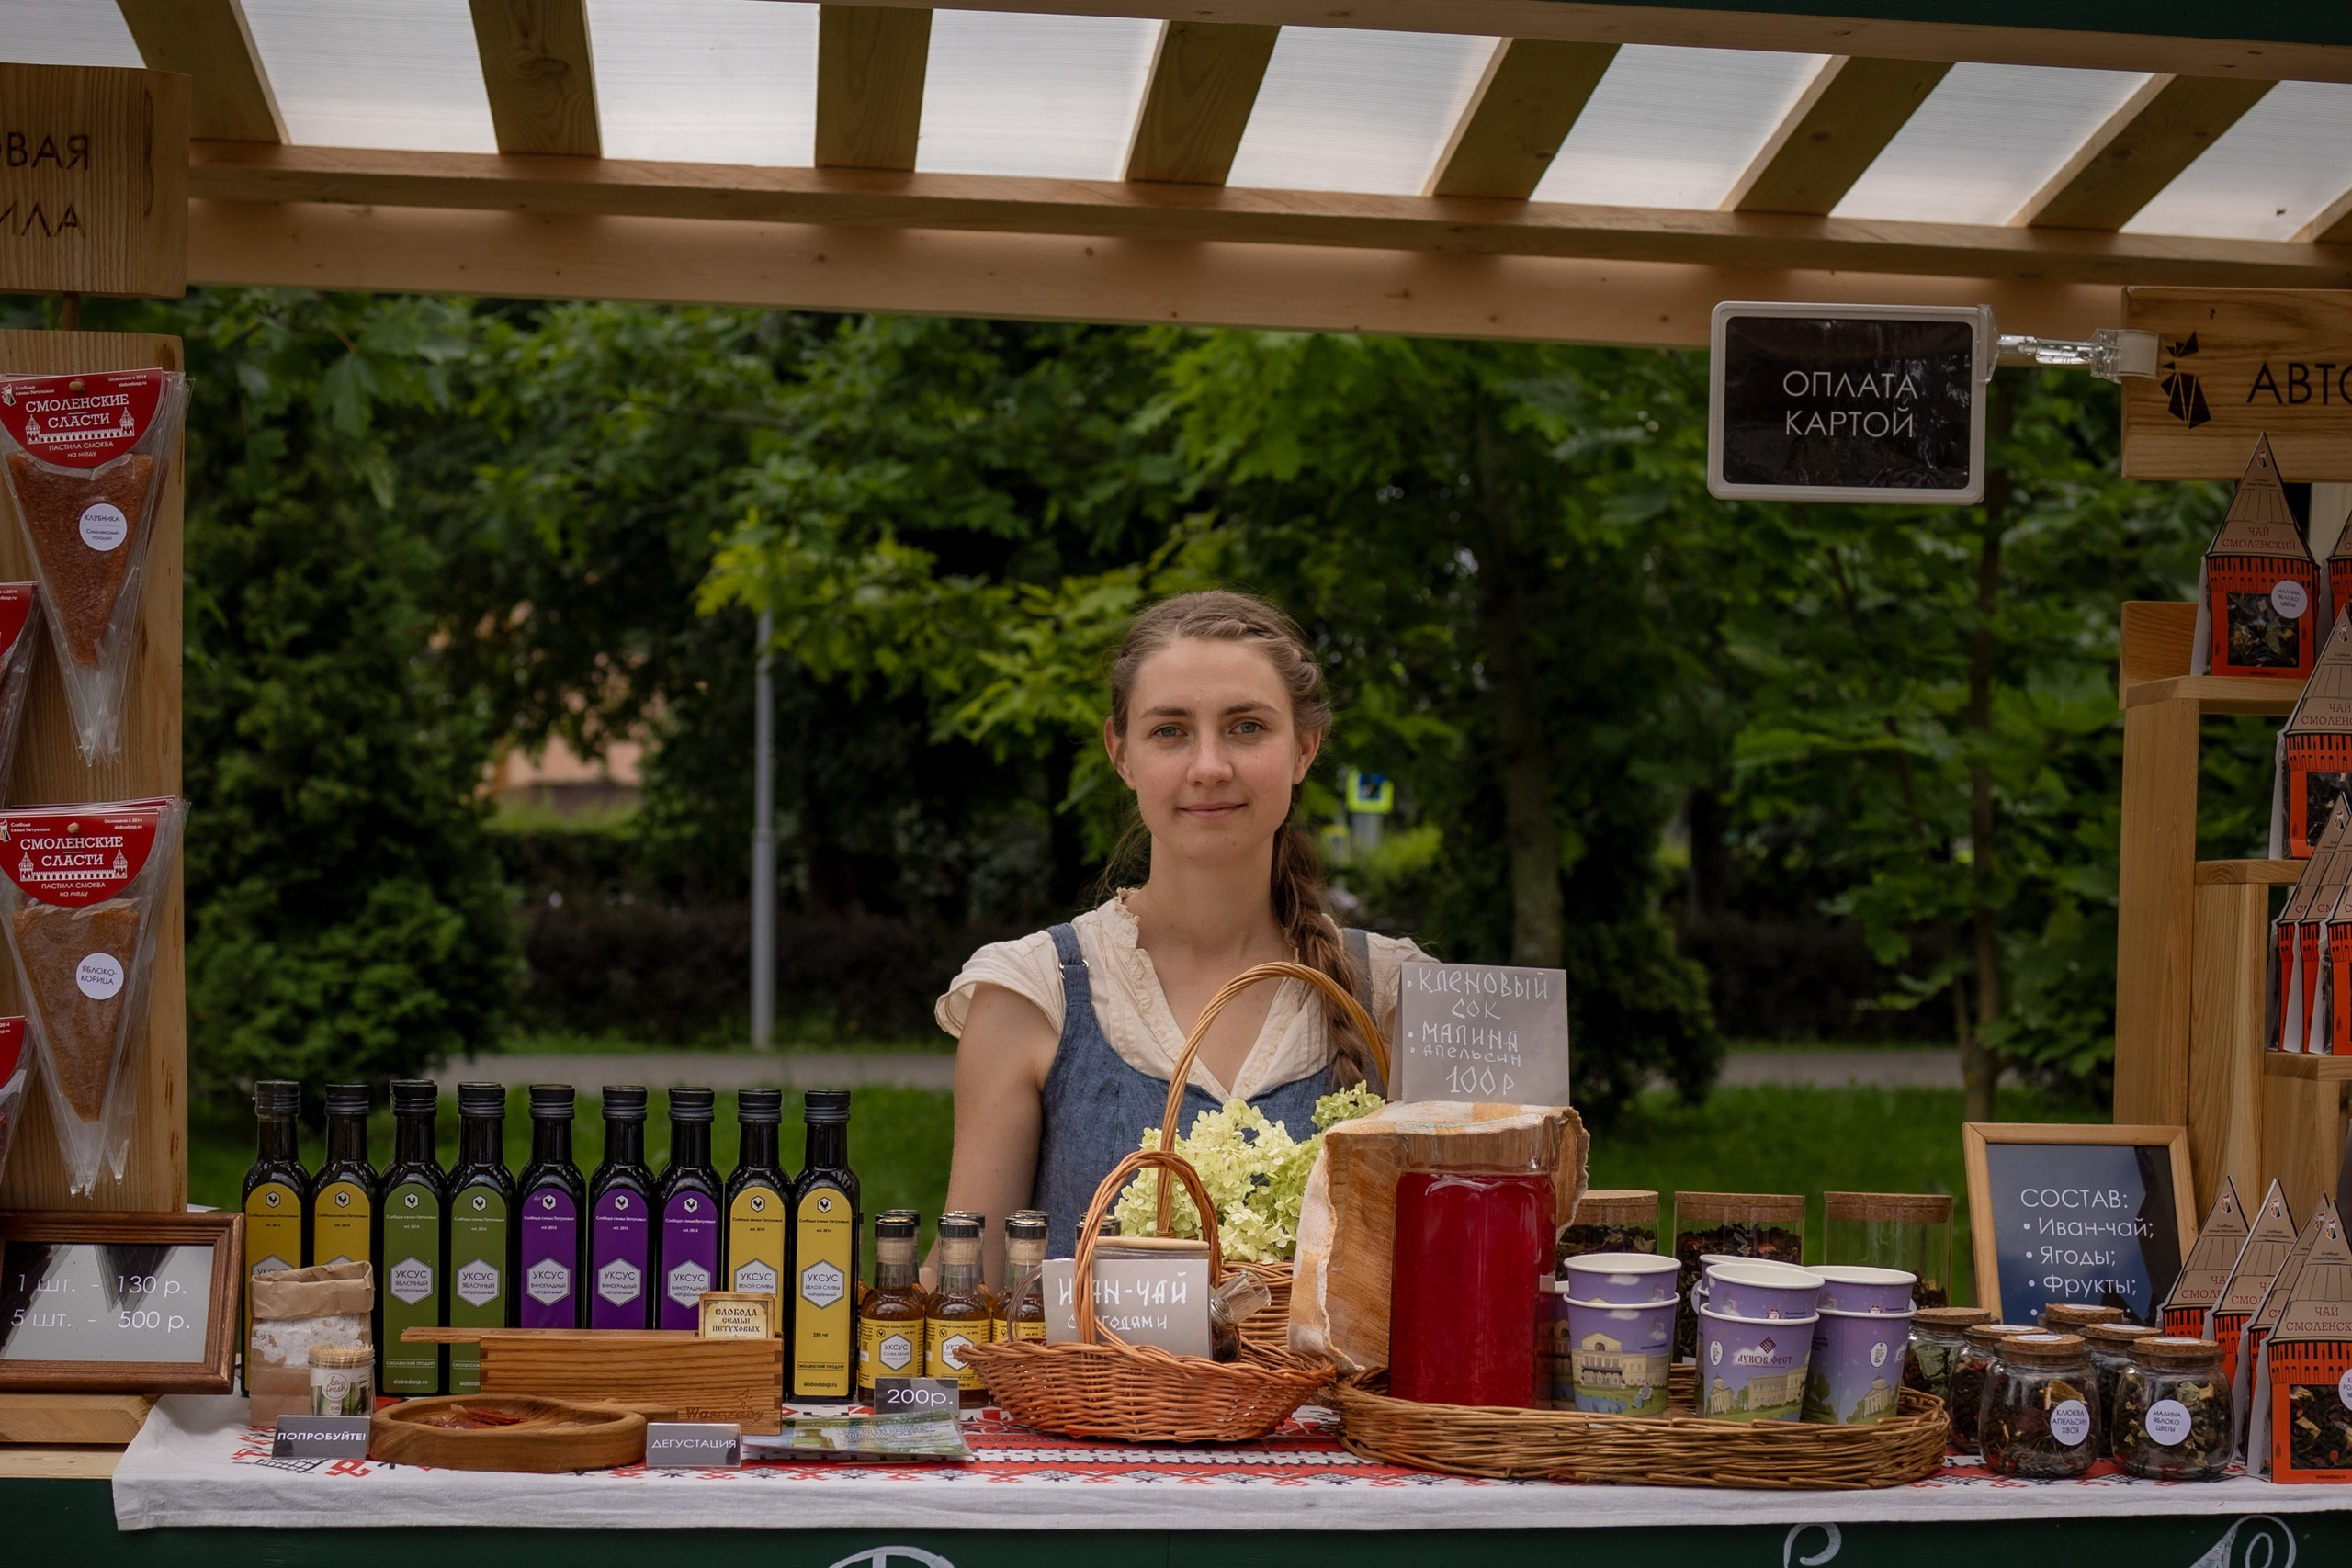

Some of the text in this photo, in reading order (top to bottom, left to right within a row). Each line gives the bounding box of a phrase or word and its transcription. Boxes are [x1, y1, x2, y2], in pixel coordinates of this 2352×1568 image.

[0, 132, 89, 170] ВАЯ
[1783, 370, 1918, 400] ОПЛАТА
[26, 393, 130, 413] СМОЛЕНСКИЕ
[48, 413, 111, 429] СЛАСТИ
[1785, 406, 1914, 438] КАРТОЙ
[49, 441, 114, 452] ПАСТИЛА СМОКВА
[77, 450, 97, 458] меду
[85, 514, 120, 523] КЛУБНИКА
[2248, 526, 2270, 536] ЧАЙ
[2222, 538, 2296, 550] СМОЛЕНСКИЙ
[2329, 703, 2352, 713] ЧАЙ
[20, 836, 124, 851] СМОЛЕНСКИЕ
[41, 854, 105, 867] СЛАСТИ
[81, 965, 118, 976] ЯБЛОКО-
[81, 976, 114, 986] КОРИЦА
[1419, 967, 1549, 1000] КЛЕНОВЫЙ
[1452, 998, 1501, 1020] СОК
[1422, 1021, 1519, 1053] МАЛИНА
[2020, 1188, 2129, 1209] СОСТАВ:
[2038, 1216, 2154, 1239] Иван-чай;
[2040, 1246, 2117, 1267] Ягоды;
[395, 1270, 428, 1279] УКСУС
[533, 1271, 564, 1280] УКСУС
[605, 1271, 636, 1280] УКСУС
[673, 1273, 706, 1282] УКСУС
[741, 1272, 772, 1281] УКСУС
[807, 1273, 839, 1282] УКСУС
[18, 1274, 26, 1292] 1
[37, 1279, 75, 1292] шт.
[118, 1275, 157, 1293] 130
[164, 1280, 187, 1298] р.
[1058, 1271, 1187, 1307] ИАН-ЧАЙ
[2043, 1274, 2137, 1299] Фрукты;
[715, 1308, 757, 1317] СЛОБОДА
[2315, 1304, 2339, 1316] ЧАЙ
[11, 1308, 25, 1327] 5
[33, 1314, 72, 1327] шт.
[118, 1311, 161, 1329] 500
[167, 1314, 191, 1334] р.
[722, 1316, 751, 1325] СЕМЬИ
[1771, 1356, 1793, 1365] ФЕСТ
[325, 1382, 348, 1395] fresh
[887, 1389, 954, 1407] 200р.
[2153, 1410, 2182, 1418] МАЛИНА
[2153, 1416, 2181, 1425] ЯБЛОКО
[277, 1431, 367, 1441] ПОПРОБУЙТЕ!
[651, 1439, 737, 1450] ДЕГУСТАЦИЯ
